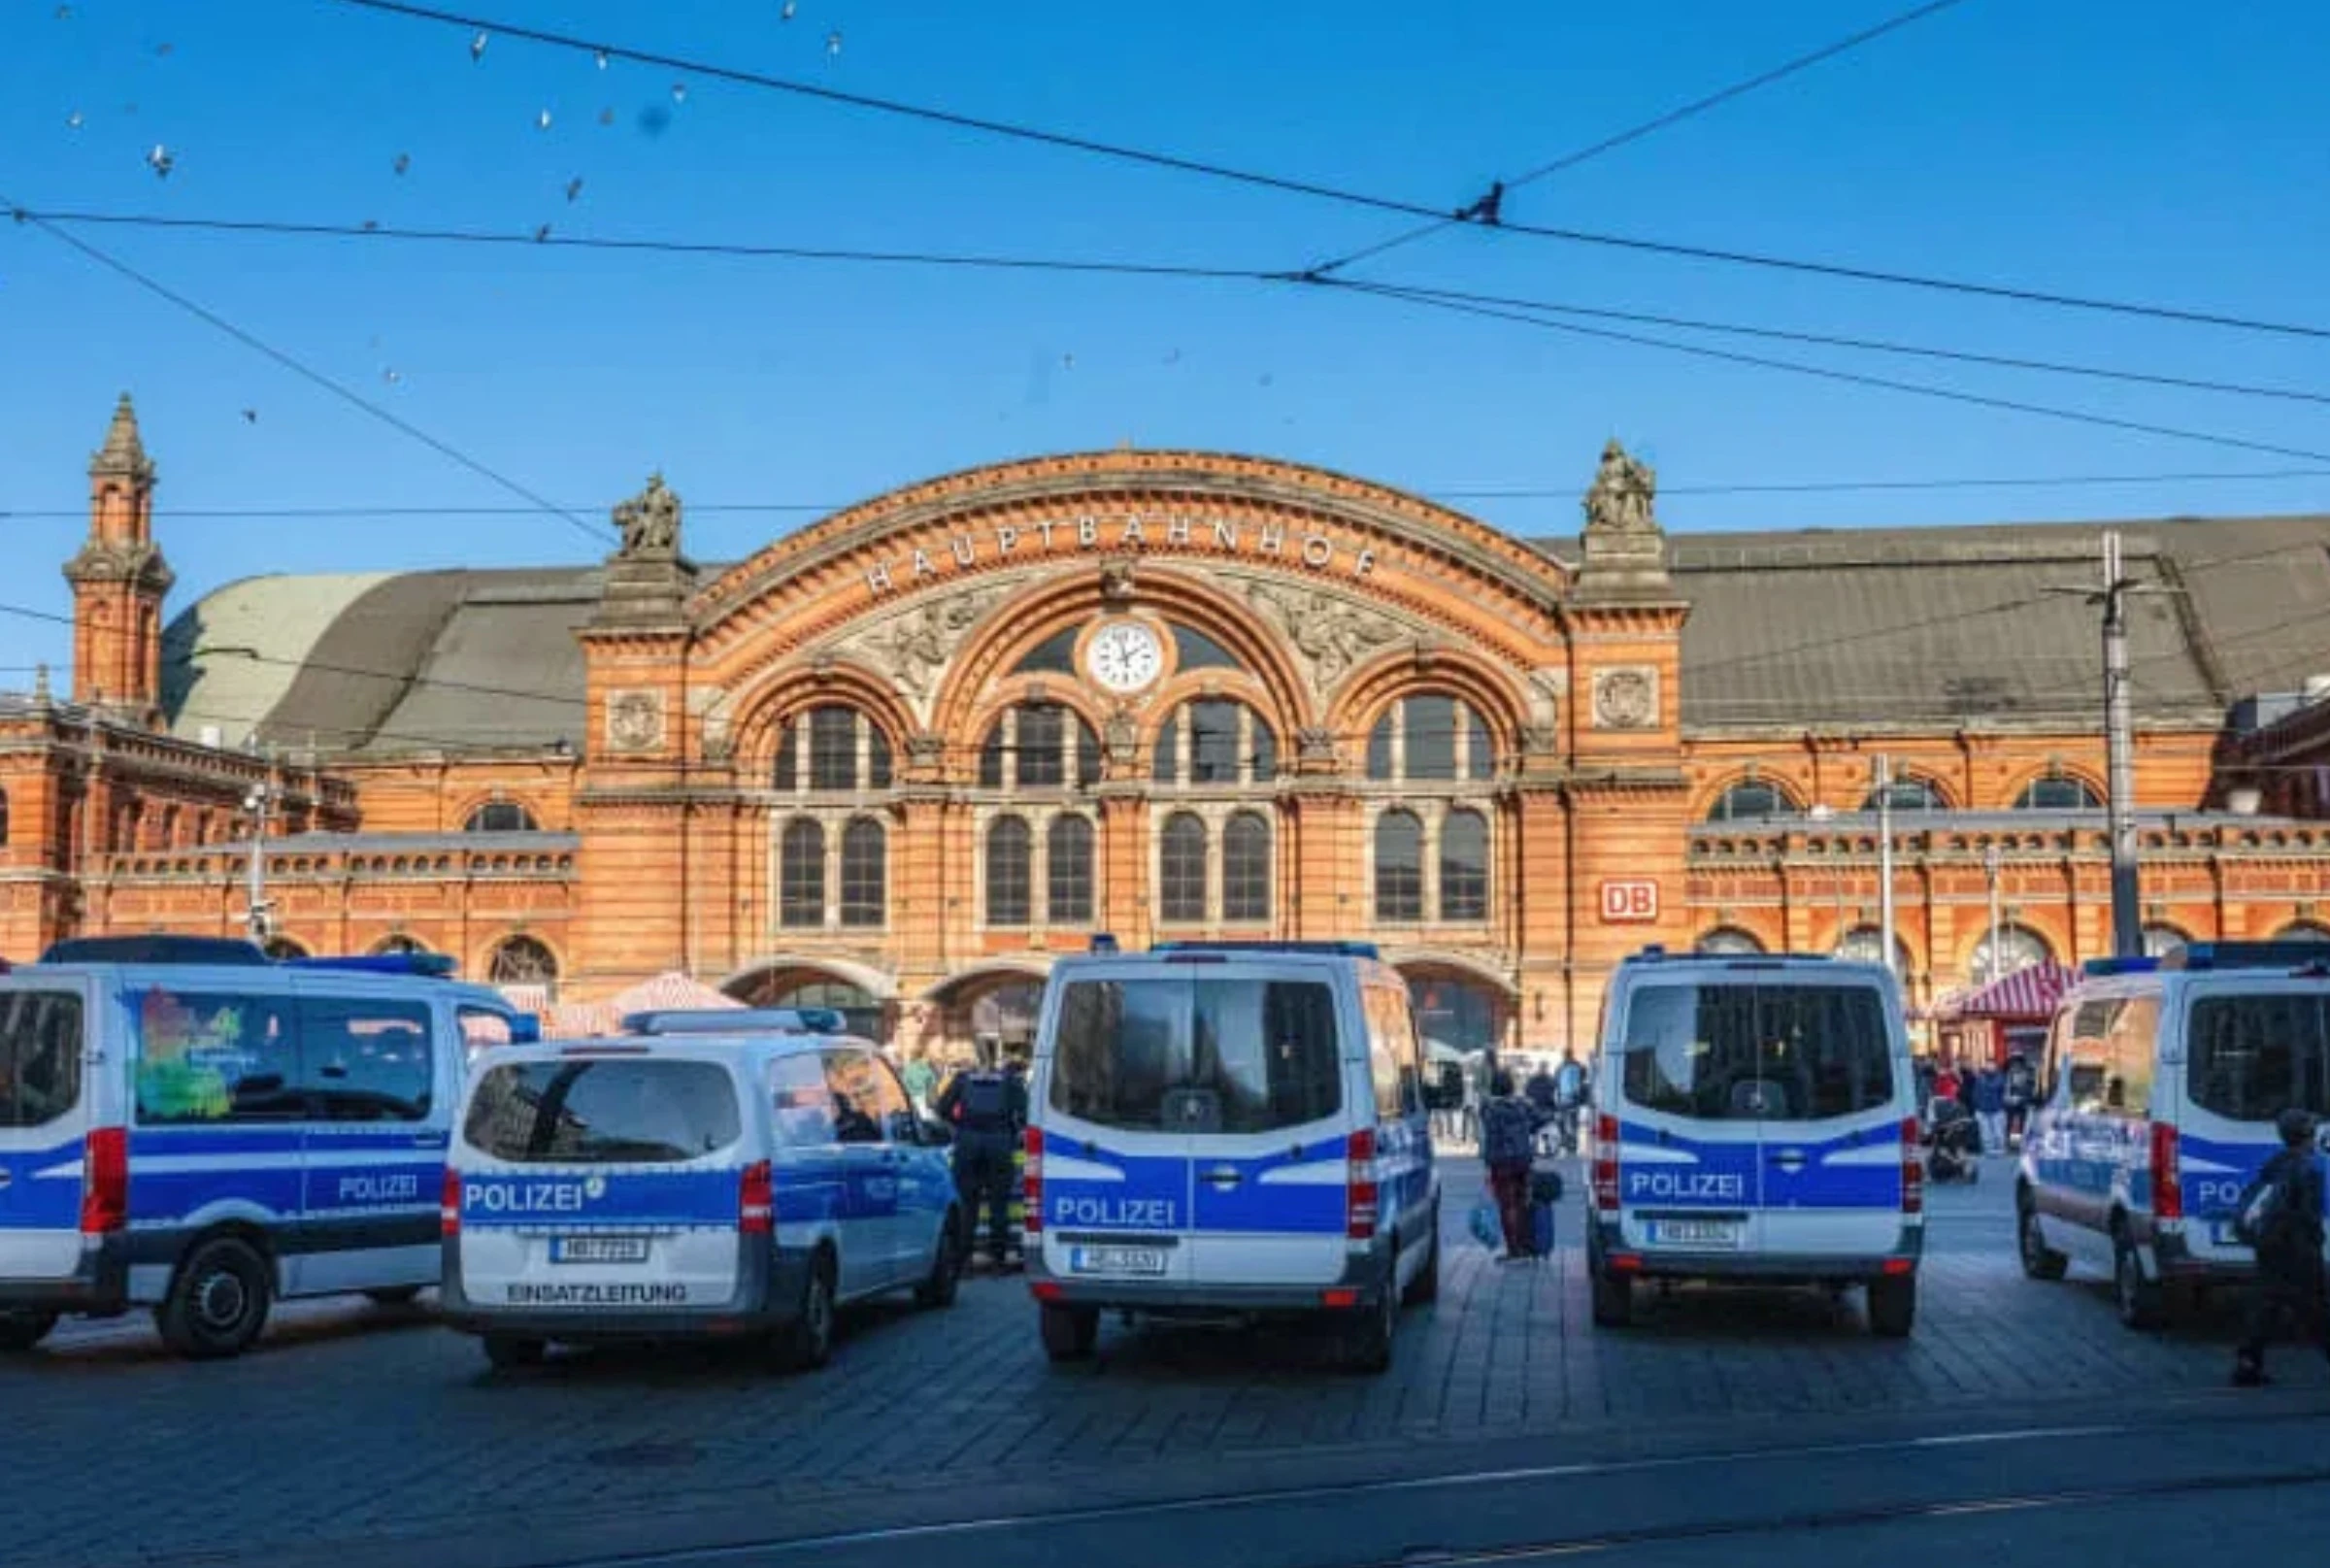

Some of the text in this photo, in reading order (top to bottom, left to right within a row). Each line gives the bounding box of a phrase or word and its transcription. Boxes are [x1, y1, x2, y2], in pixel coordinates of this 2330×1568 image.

[867, 516, 1375, 591] HAUPTBAHNHOF
[1608, 886, 1652, 913] DB
[339, 1174, 417, 1200] POLIZEI
[465, 1183, 582, 1212] POLIZEI
[1631, 1173, 1743, 1199] POLIZEI
[1056, 1196, 1176, 1227] POLIZEI
[508, 1284, 687, 1303] EINSATZLEITUNG
